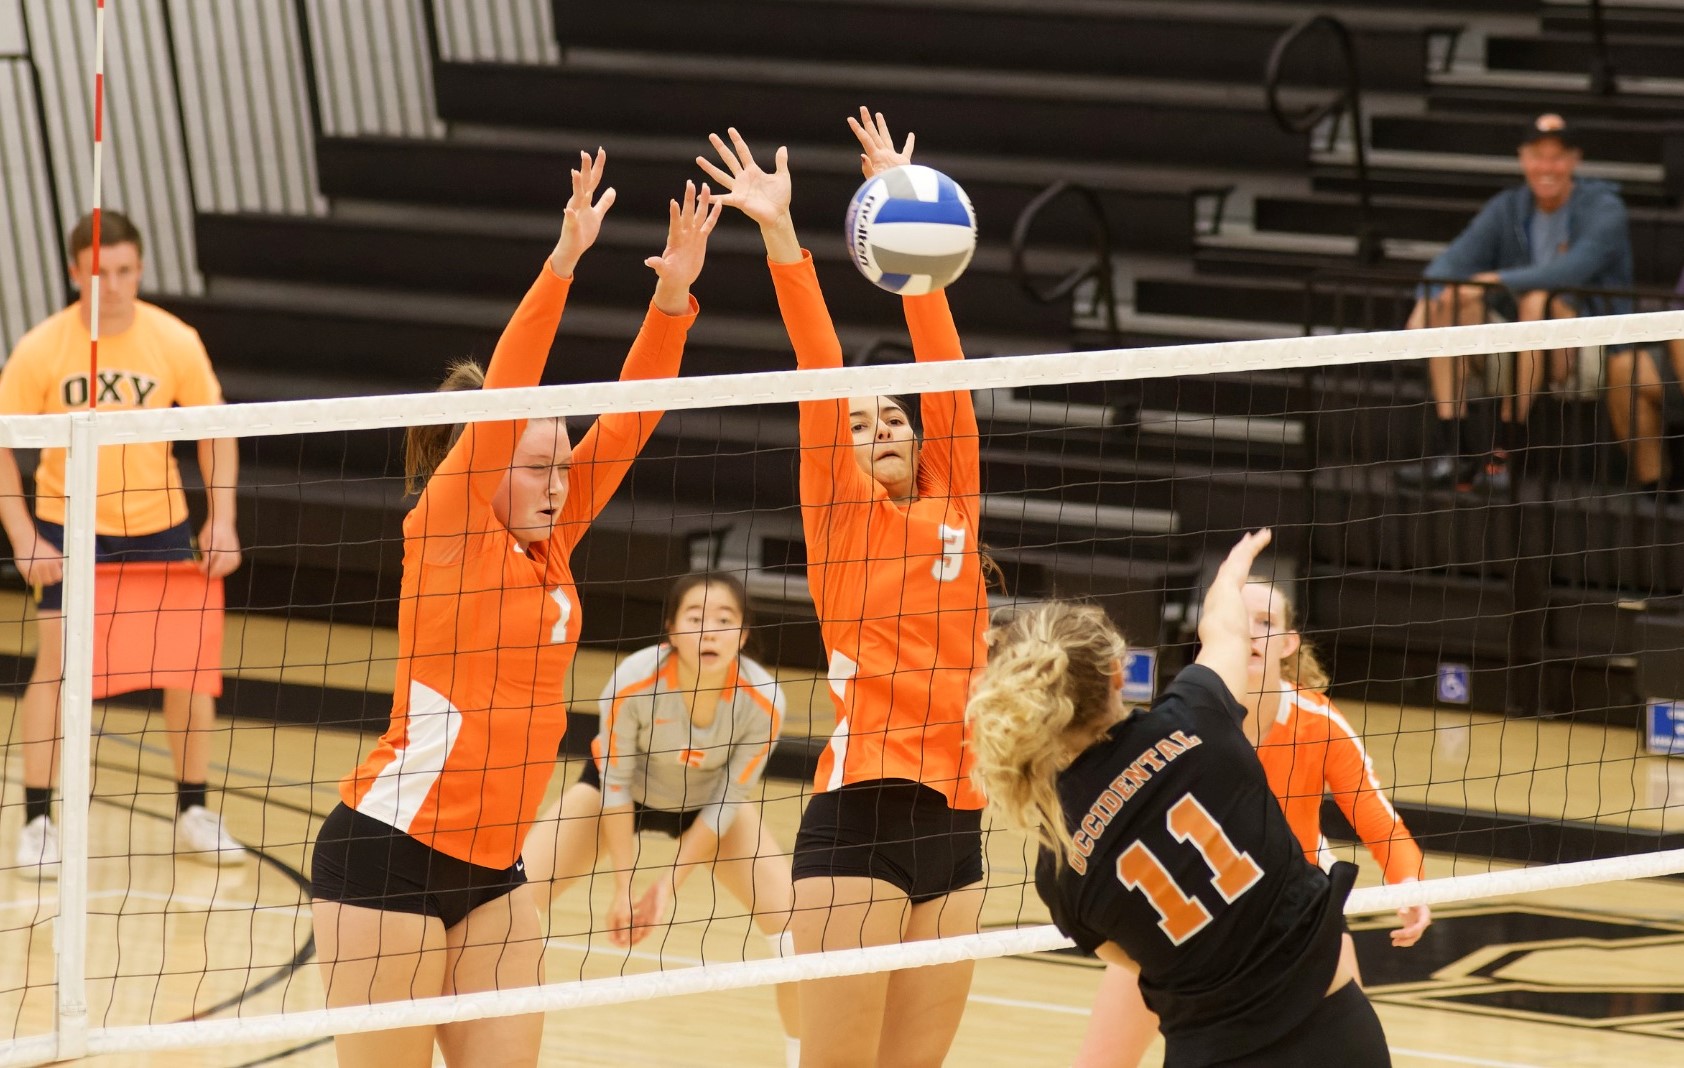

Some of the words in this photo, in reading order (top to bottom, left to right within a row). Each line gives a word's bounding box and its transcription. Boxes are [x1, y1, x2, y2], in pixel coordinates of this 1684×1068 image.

[856, 194, 877, 268] molten
[62, 371, 157, 407] OXY
[931, 523, 966, 583] 3
[1067, 729, 1204, 877] OCCIDENTAL
[1115, 791, 1266, 948] 11
